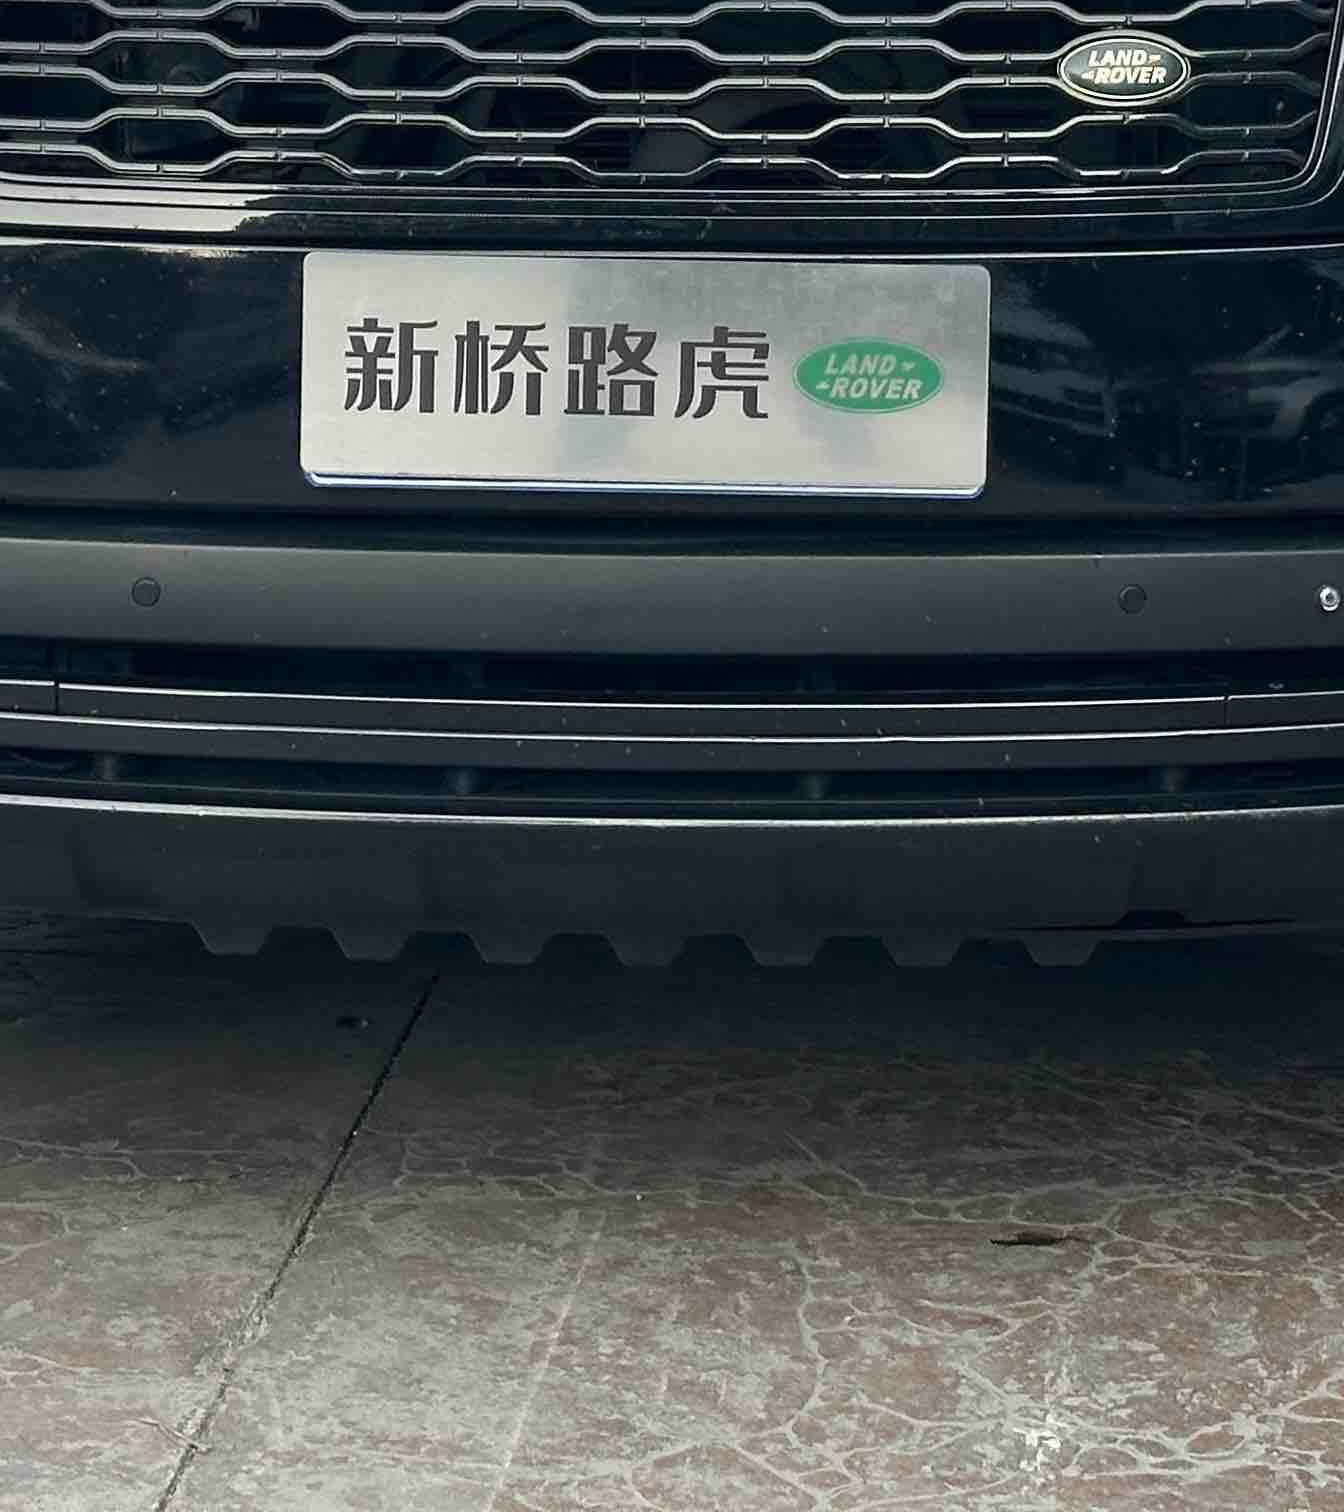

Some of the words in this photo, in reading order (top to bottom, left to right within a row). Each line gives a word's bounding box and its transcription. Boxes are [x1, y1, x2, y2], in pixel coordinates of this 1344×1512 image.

[1087, 48, 1148, 67] LAND
[1093, 66, 1168, 85] ROVER
[343, 317, 770, 419] 新桥路虎
[823, 352, 898, 376] LAND
[829, 375, 924, 400] ROVER
